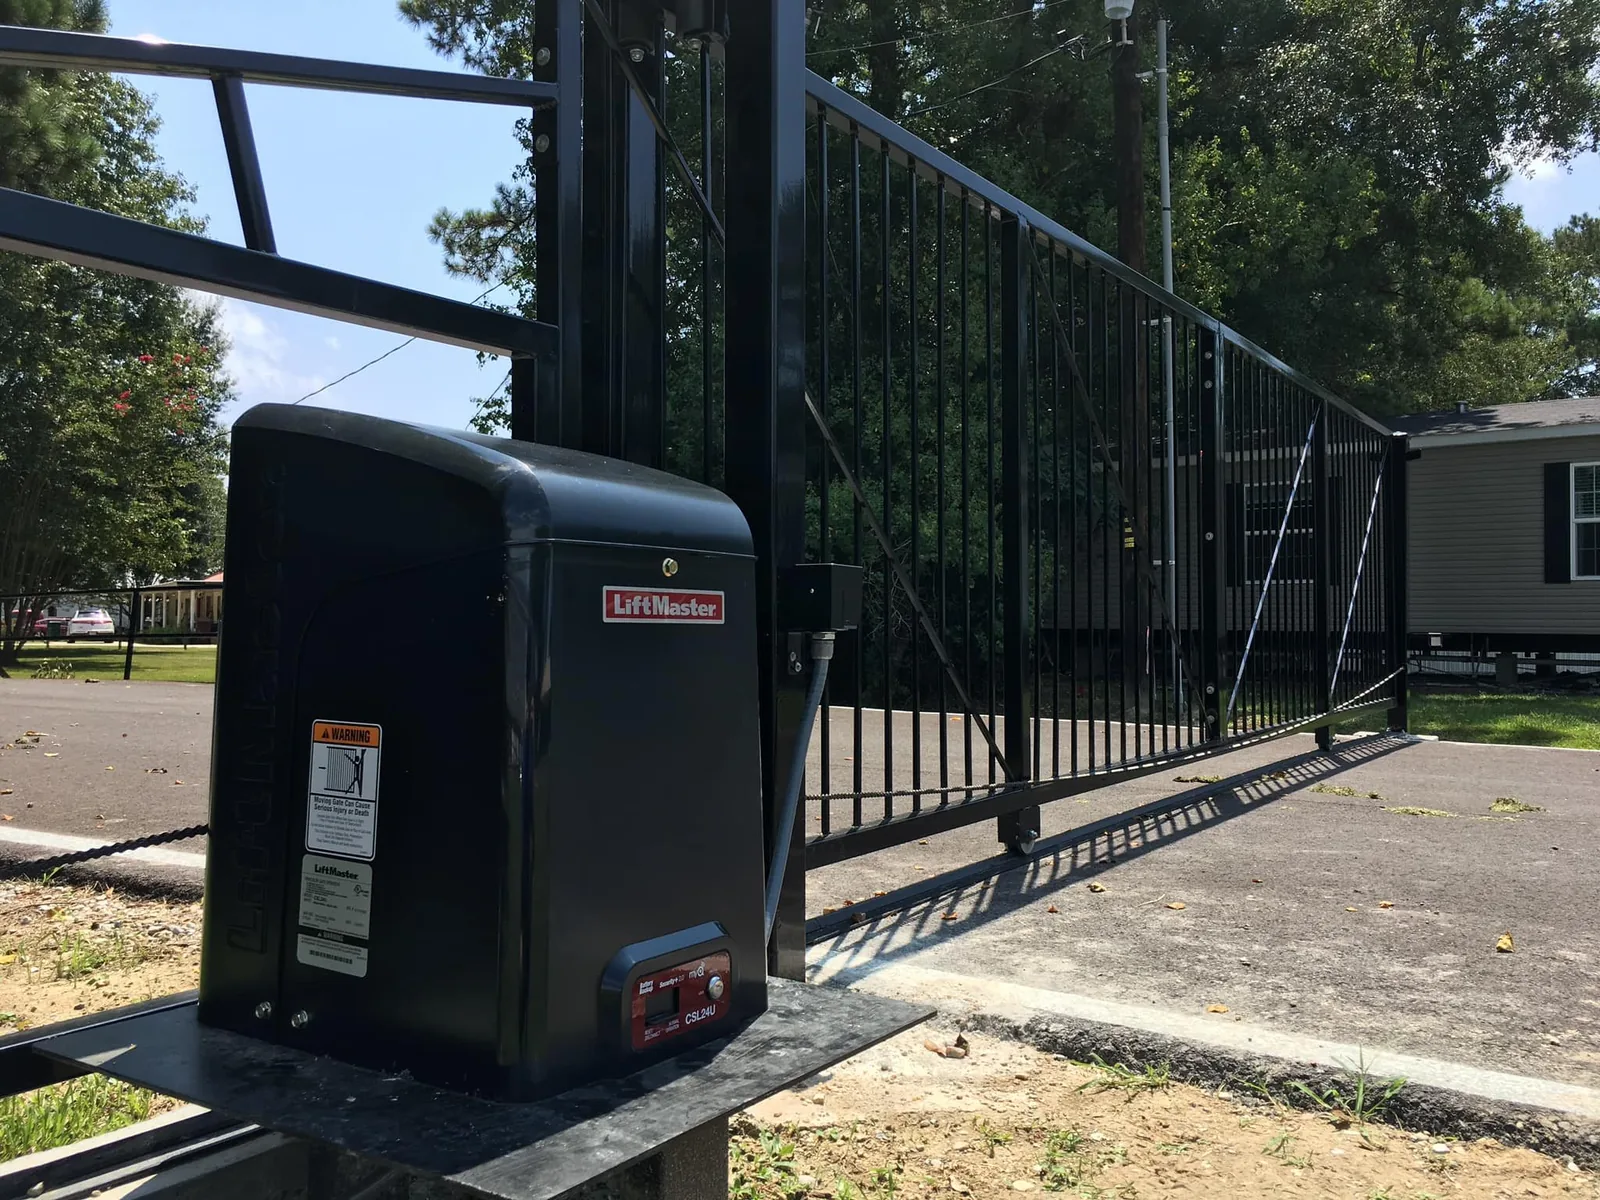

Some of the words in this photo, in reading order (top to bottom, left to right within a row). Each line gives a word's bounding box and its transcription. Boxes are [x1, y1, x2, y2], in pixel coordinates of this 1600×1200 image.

[613, 593, 716, 617] LiftMaster
[331, 728, 371, 743] WARNING
[314, 796, 332, 806] Moving
[355, 801, 371, 809] Cause
[314, 803, 332, 812] Serious
[333, 806, 347, 815] Injury
[355, 808, 370, 817] Death
[314, 864, 359, 880] LiftMaster
[688, 966, 705, 980] myQ
[685, 1004, 716, 1025] CSL24U
